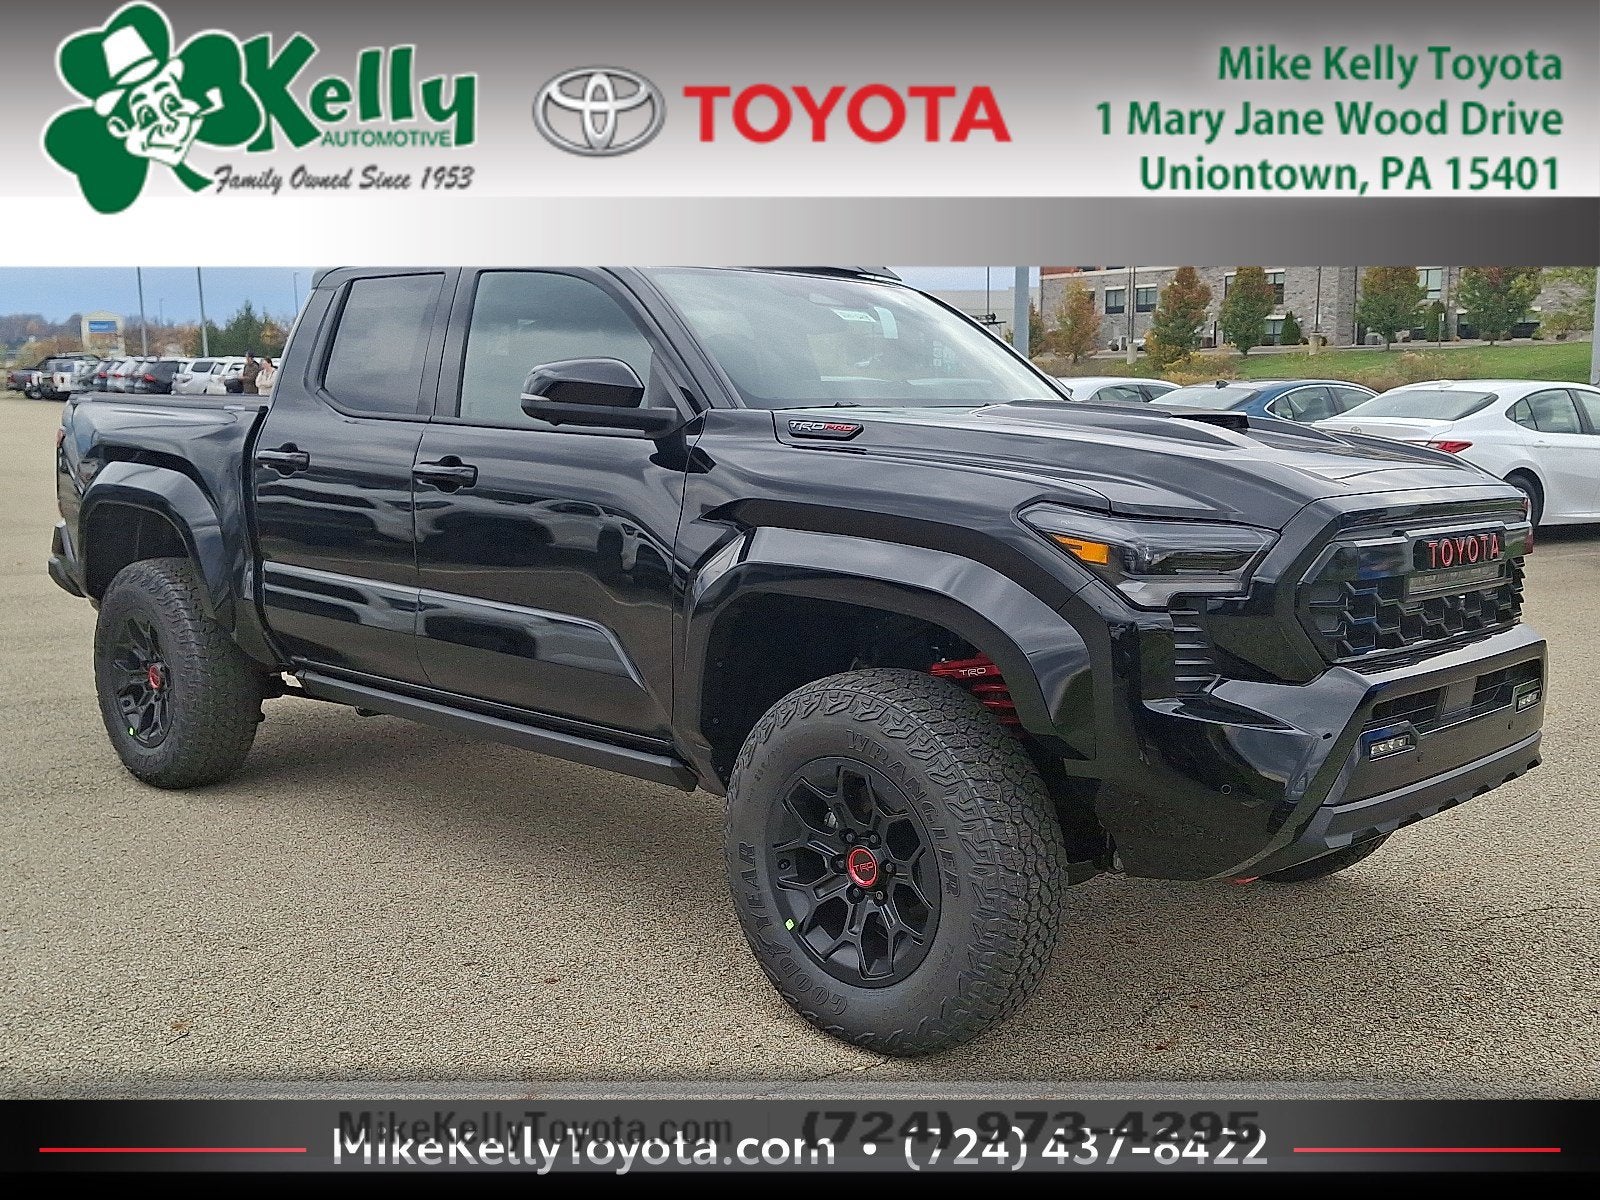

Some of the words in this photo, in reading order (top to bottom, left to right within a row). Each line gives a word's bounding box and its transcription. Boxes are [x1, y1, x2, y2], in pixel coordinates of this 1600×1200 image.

[1428, 533, 1500, 568] TOYOTA
[958, 667, 987, 677] TRD
[852, 861, 875, 873] TRD
